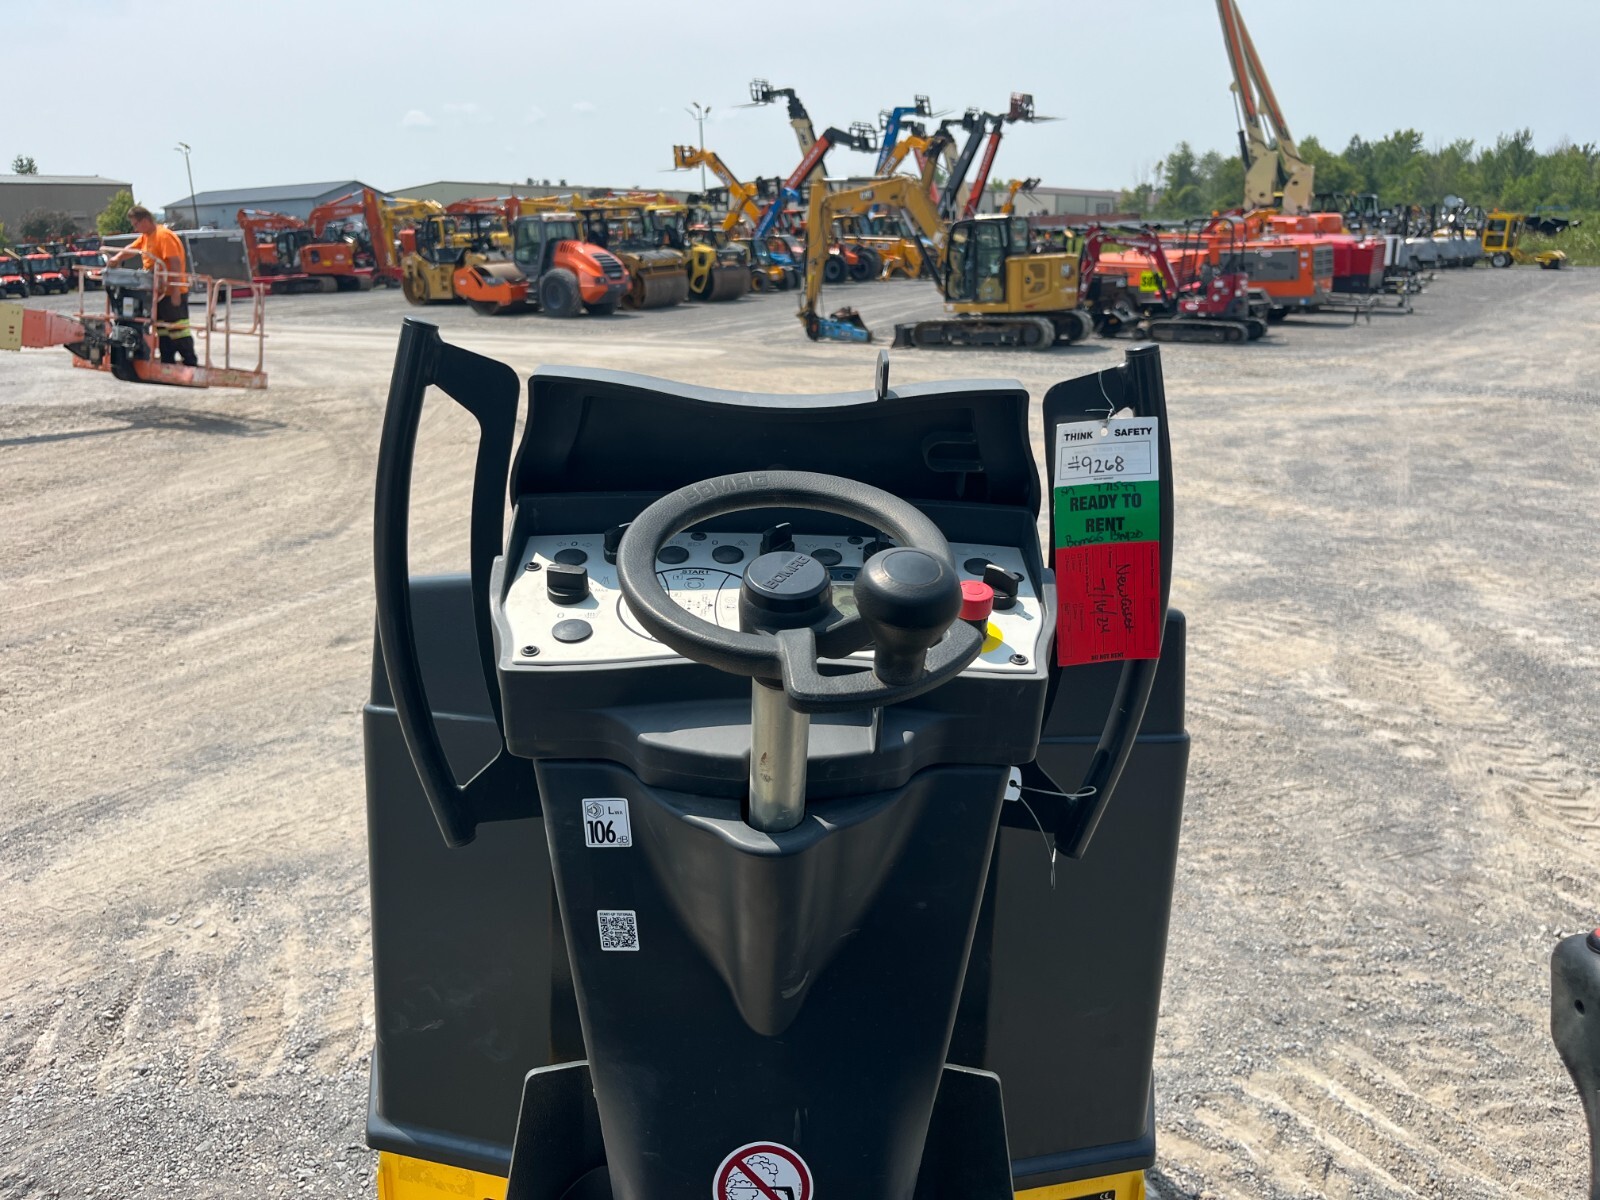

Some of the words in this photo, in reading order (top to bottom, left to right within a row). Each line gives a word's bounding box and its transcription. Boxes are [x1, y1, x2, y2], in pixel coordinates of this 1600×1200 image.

[1064, 431, 1093, 441] THINK
[1114, 427, 1152, 437] SAFETY
[1067, 455, 1124, 474] #9268
[678, 472, 768, 504] BOMAG
[1070, 494, 1118, 512] READY
[1122, 493, 1142, 508] TO
[1085, 517, 1125, 533] RENT
[762, 555, 811, 589] BOMAG
[587, 820, 616, 843] 106
